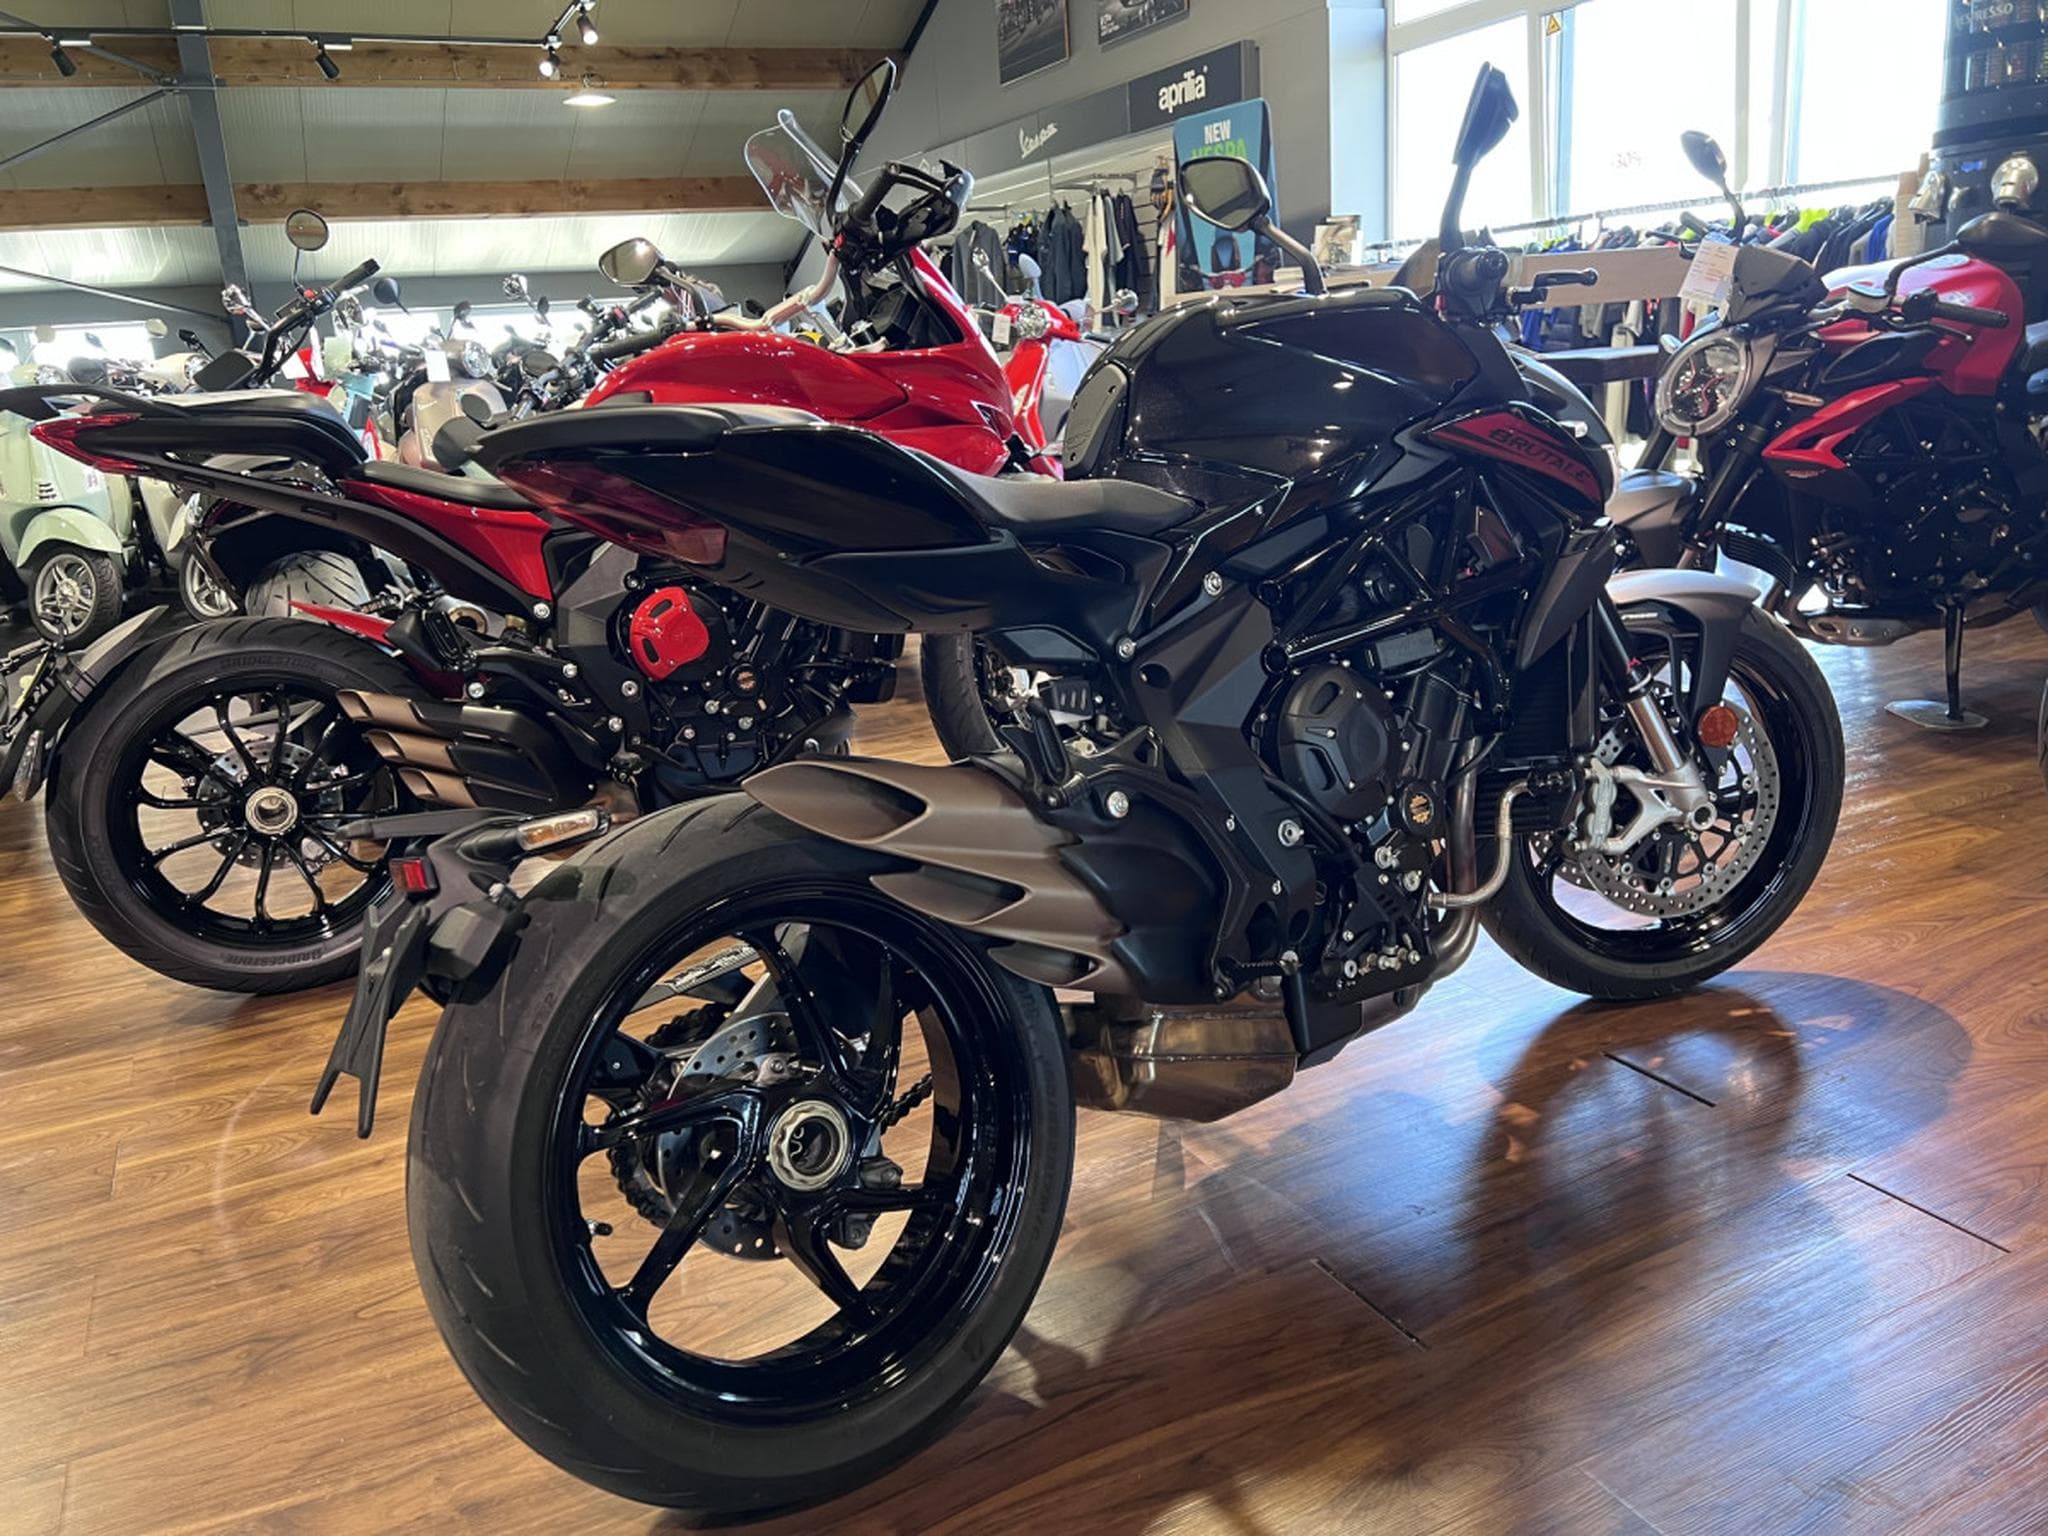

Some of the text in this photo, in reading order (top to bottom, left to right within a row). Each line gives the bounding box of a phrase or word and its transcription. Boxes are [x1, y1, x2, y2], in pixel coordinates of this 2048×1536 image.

[1158, 69, 1207, 114] aprilia
[1019, 122, 1058, 159] Vespa
[1204, 119, 1231, 144] NEW
[1489, 426, 1593, 482] BRUTALE
